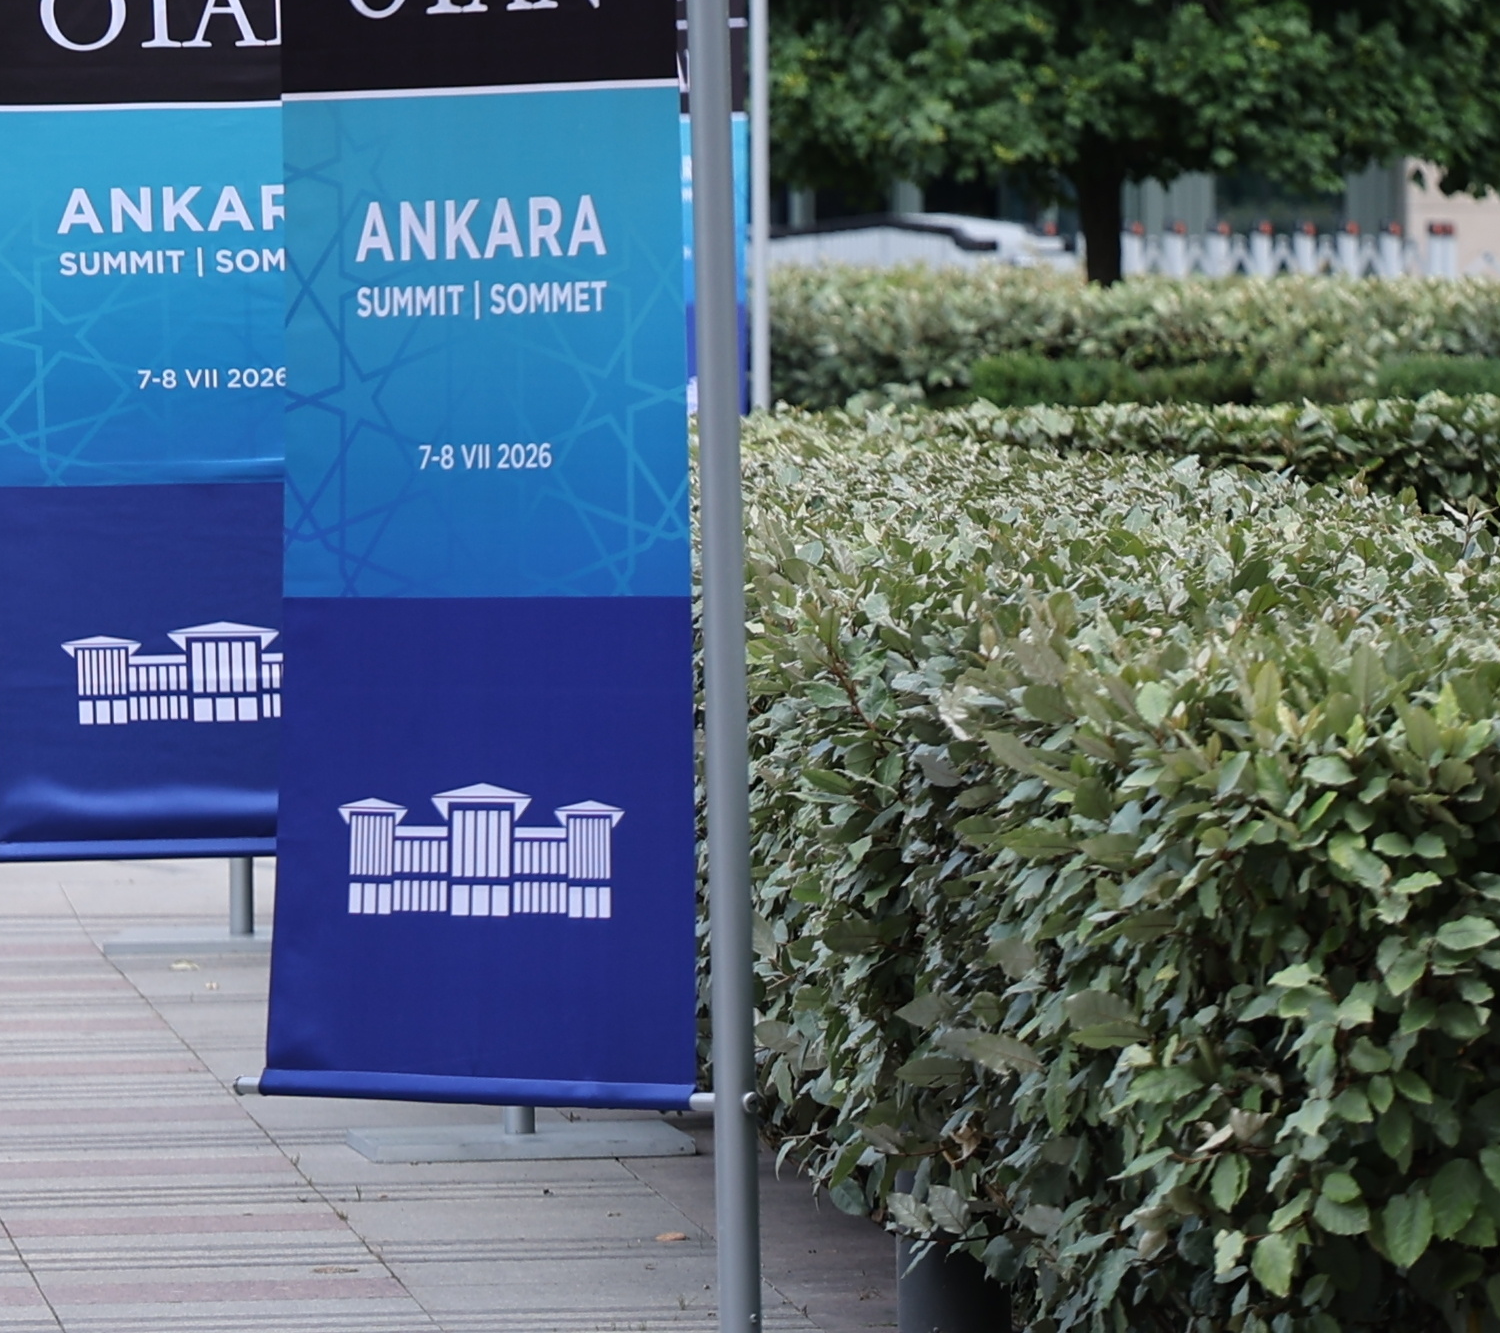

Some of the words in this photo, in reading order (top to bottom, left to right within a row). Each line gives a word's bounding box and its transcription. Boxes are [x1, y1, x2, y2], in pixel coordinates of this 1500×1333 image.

[58, 184, 284, 234] ANKAR
[356, 195, 606, 262] ANKARA
[60, 250, 185, 276] SUMMIT
[216, 248, 285, 273] SOM
[357, 285, 464, 317] SUMMIT
[491, 281, 607, 314] SOMMET
[138, 369, 177, 389] 7-8
[185, 369, 217, 388] VII
[419, 445, 454, 469] 7-8
[461, 444, 490, 469] VII
[498, 443, 552, 468] 2026
